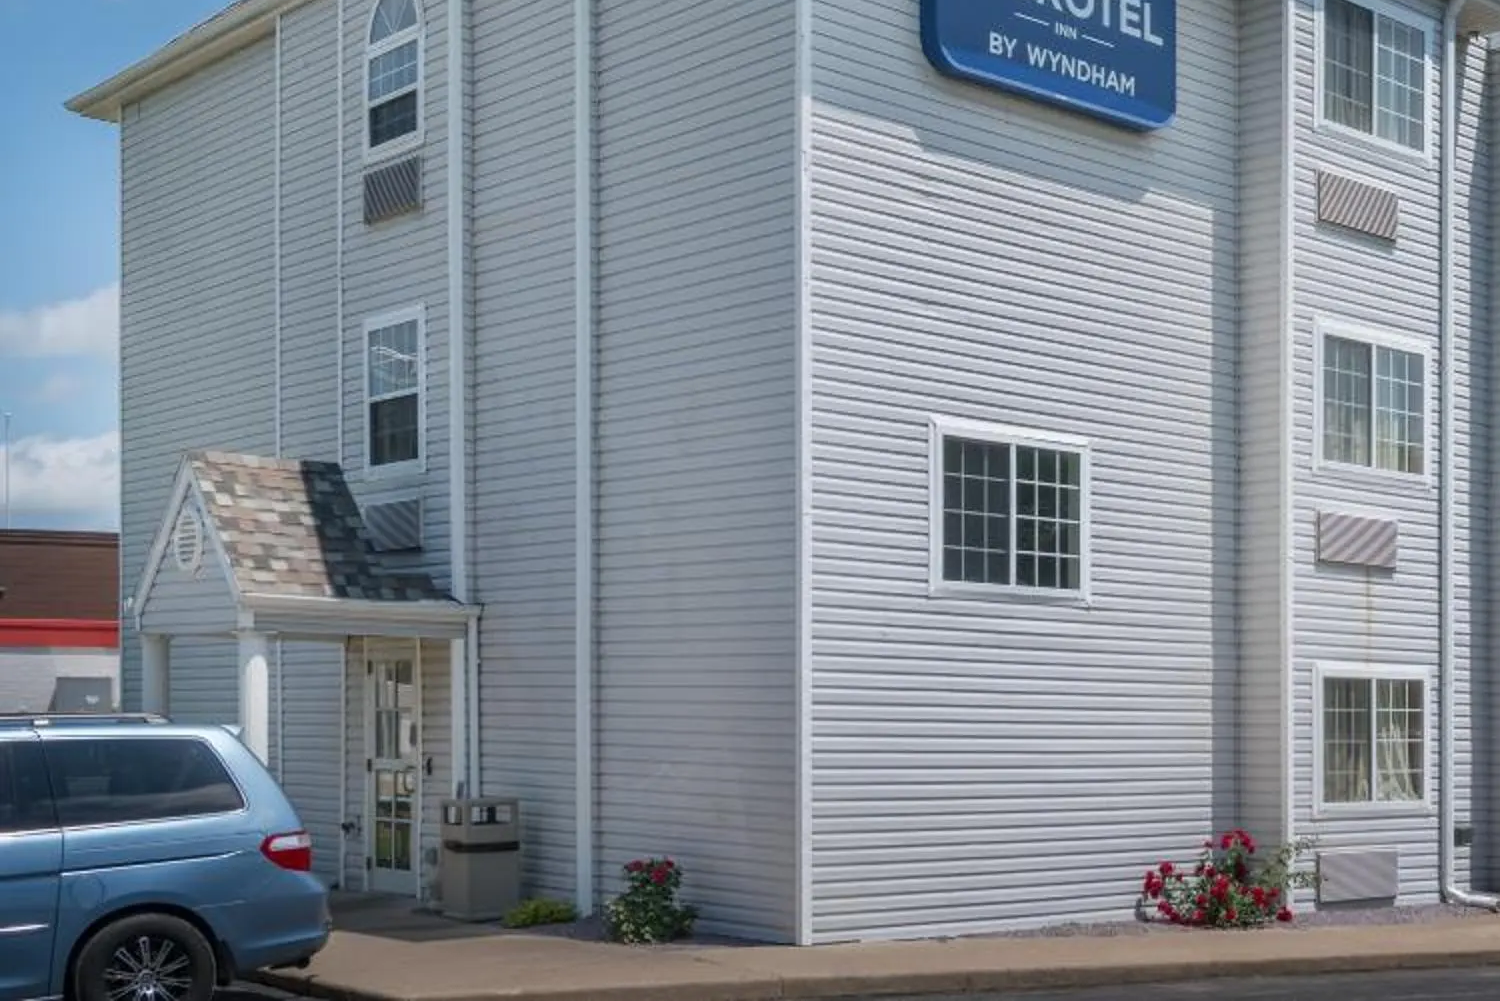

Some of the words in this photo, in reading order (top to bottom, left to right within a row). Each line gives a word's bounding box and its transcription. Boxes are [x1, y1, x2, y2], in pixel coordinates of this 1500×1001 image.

[1055, 22, 1077, 40] INN
[989, 30, 1017, 59] BY
[1026, 42, 1136, 97] WYNDHAM
